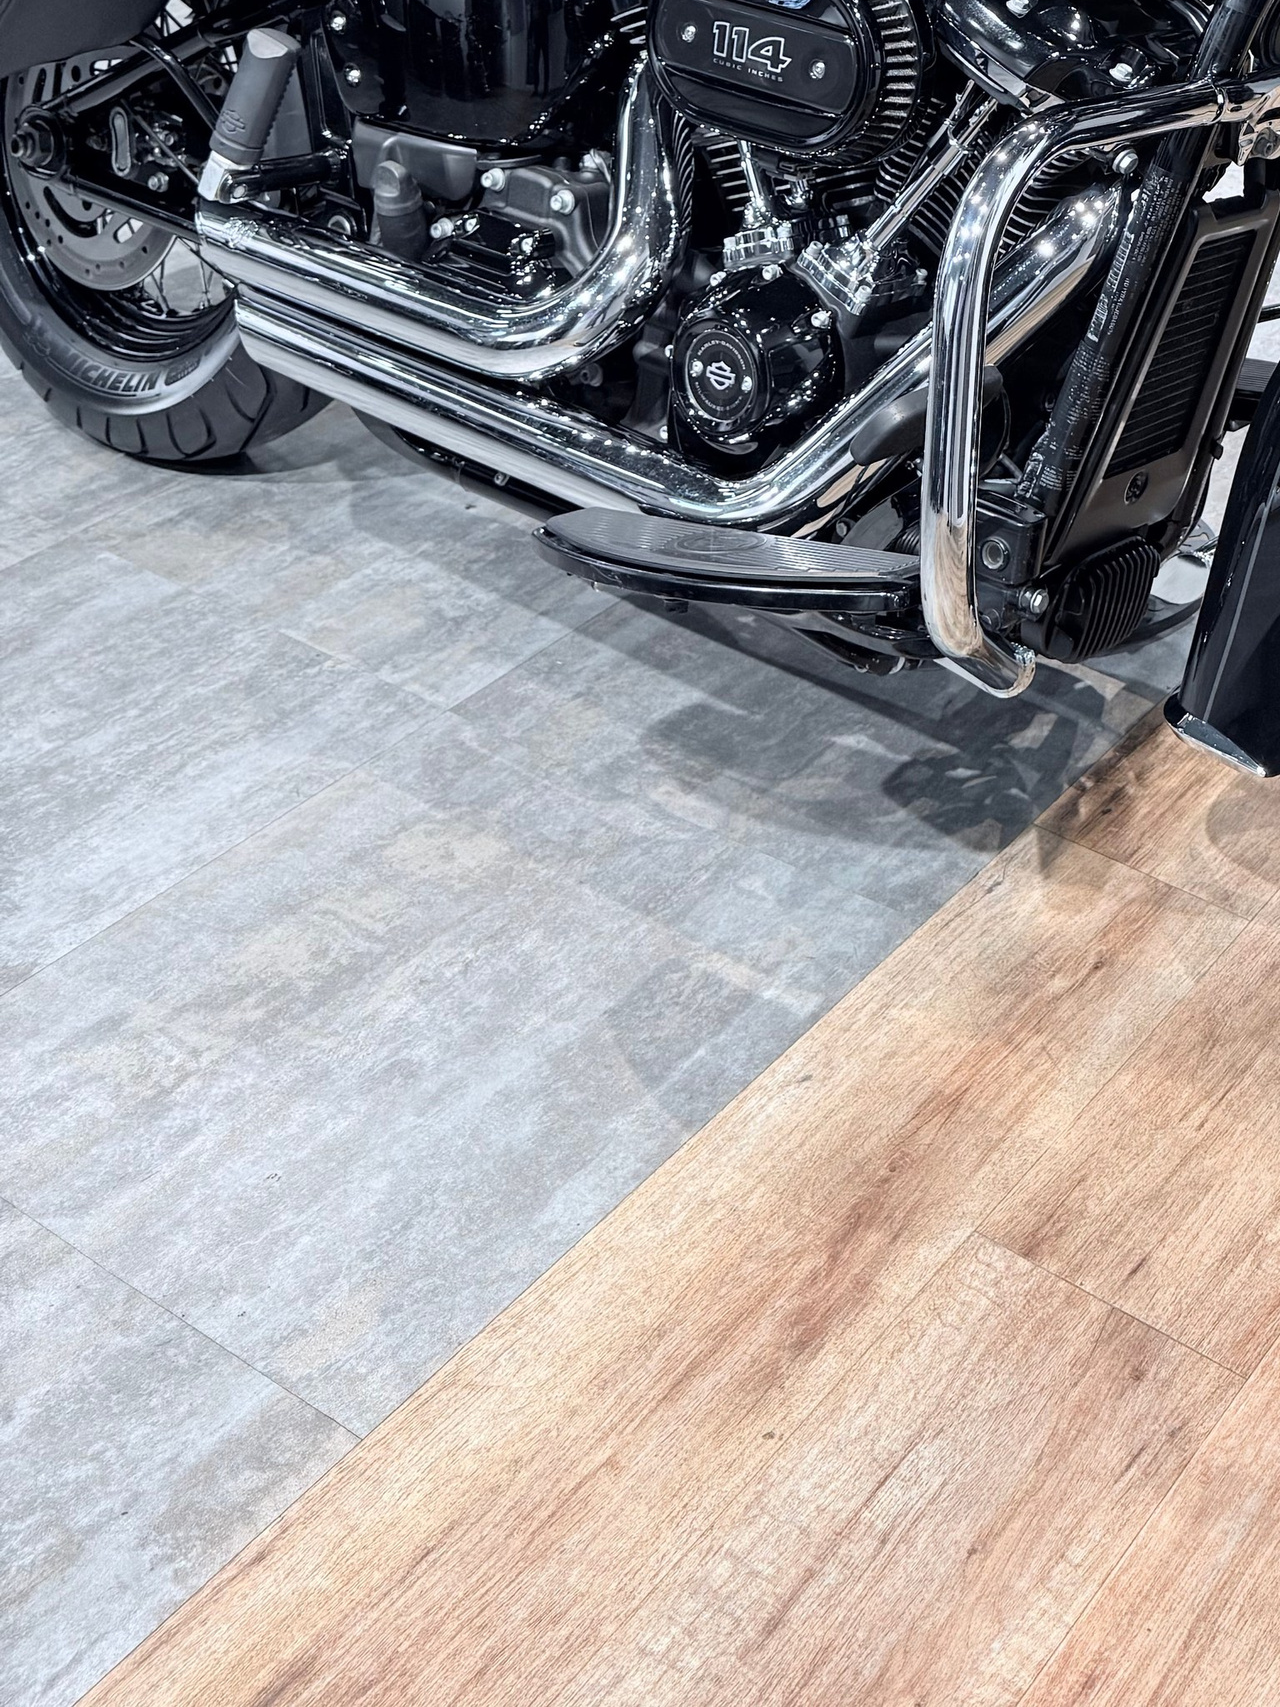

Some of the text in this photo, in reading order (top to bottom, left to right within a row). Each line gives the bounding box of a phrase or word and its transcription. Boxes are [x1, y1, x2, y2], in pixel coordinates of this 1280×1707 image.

[712, 20, 793, 74] 114
[712, 57, 784, 83] CUBIC INCHES
